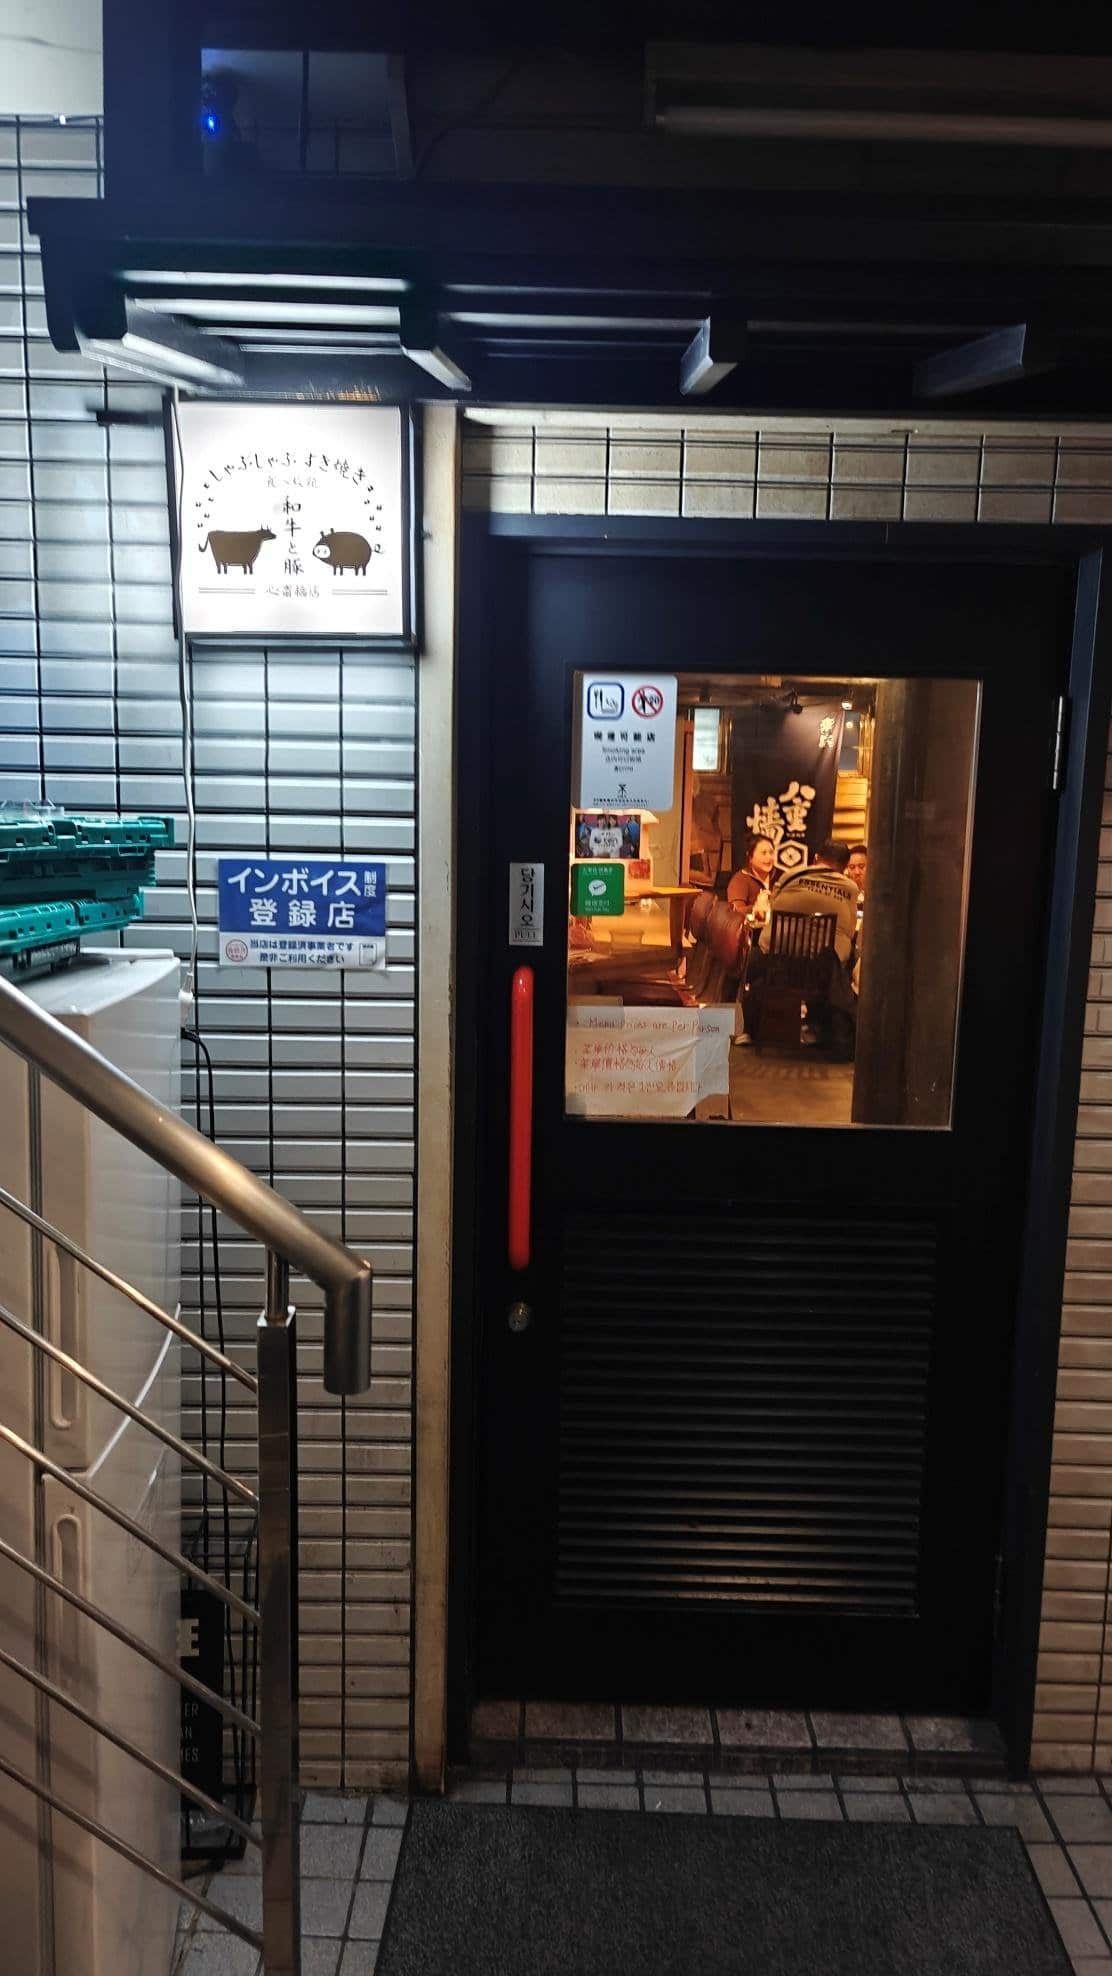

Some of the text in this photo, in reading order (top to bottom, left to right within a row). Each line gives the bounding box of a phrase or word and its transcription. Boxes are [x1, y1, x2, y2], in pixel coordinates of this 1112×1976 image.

[209, 452, 367, 485] しゃぶしゃぶ すき焼き
[282, 495, 305, 576] 和牛と豚
[227, 866, 377, 898] インボイス 制度
[519, 867, 536, 927] 당기시오
[249, 898, 356, 929] 登録店
[250, 939, 354, 952] 当店は登録済事業者です
[259, 952, 345, 965] 是非ご利用ください
